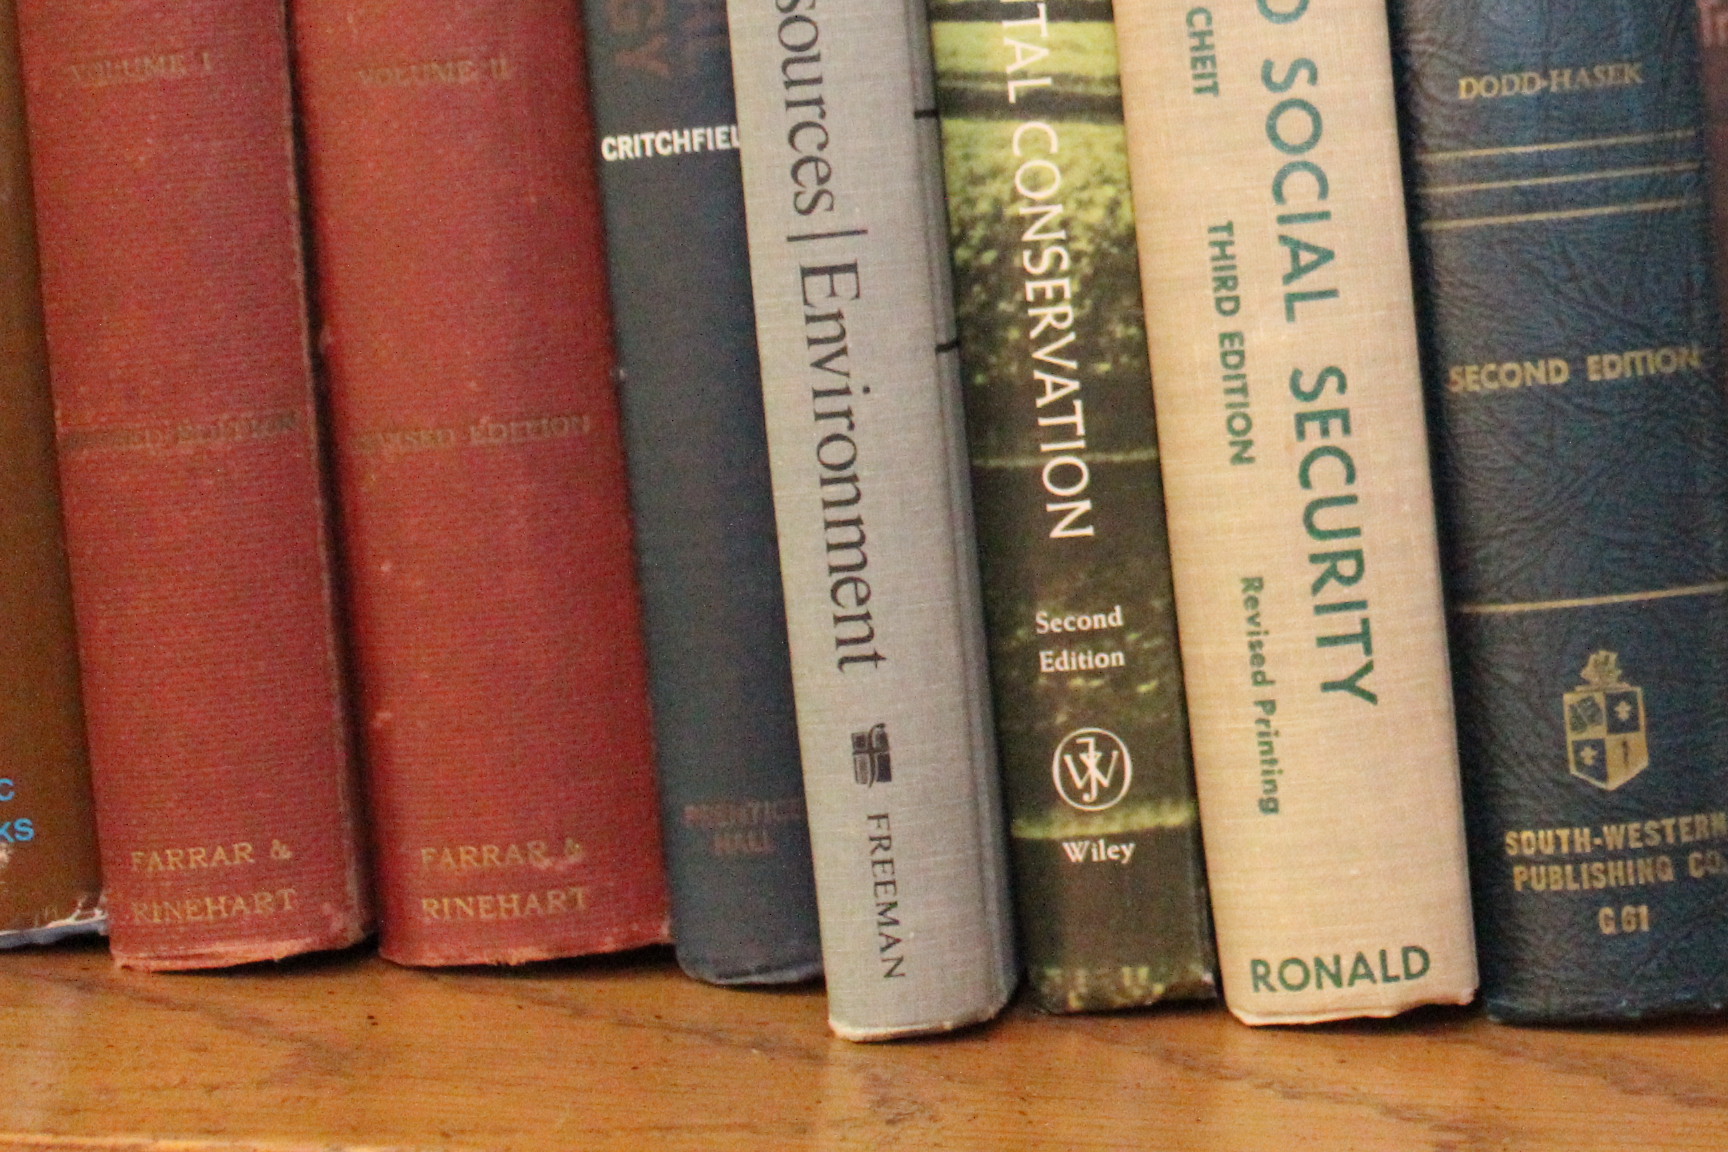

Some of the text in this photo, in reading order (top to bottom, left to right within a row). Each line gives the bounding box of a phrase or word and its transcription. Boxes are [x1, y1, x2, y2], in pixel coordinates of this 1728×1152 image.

[1185, 5, 1219, 97] CHEIT
[358, 59, 478, 89] VOLUME
[1457, 62, 1644, 101] DODD-HASEK
[1261, 57, 1340, 322] SOCIAL
[1012, 120, 1095, 538] CONSERVATION
[1207, 220, 1256, 465] THIRD EDITION
[1448, 348, 1701, 394] SECOND EDITION
[799, 258, 887, 673] Environment
[1289, 365, 1378, 706] SECURITY
[1035, 606, 1124, 635] Second
[1039, 649, 1126, 674] Edition
[1240, 576, 1285, 816] Revised Printing
[420, 840, 548, 871] FARRAR
[1062, 840, 1136, 865] Wiley
[1505, 811, 1728, 856] SOUTH-WESTERN
[131, 839, 292, 875] FARRAR &
[1512, 855, 1675, 892] PUBLISHING
[132, 887, 298, 924] RINEHART
[421, 886, 590, 922] RINEHART
[866, 812, 906, 980] FREEMAN
[1249, 945, 1430, 993] RONALD
